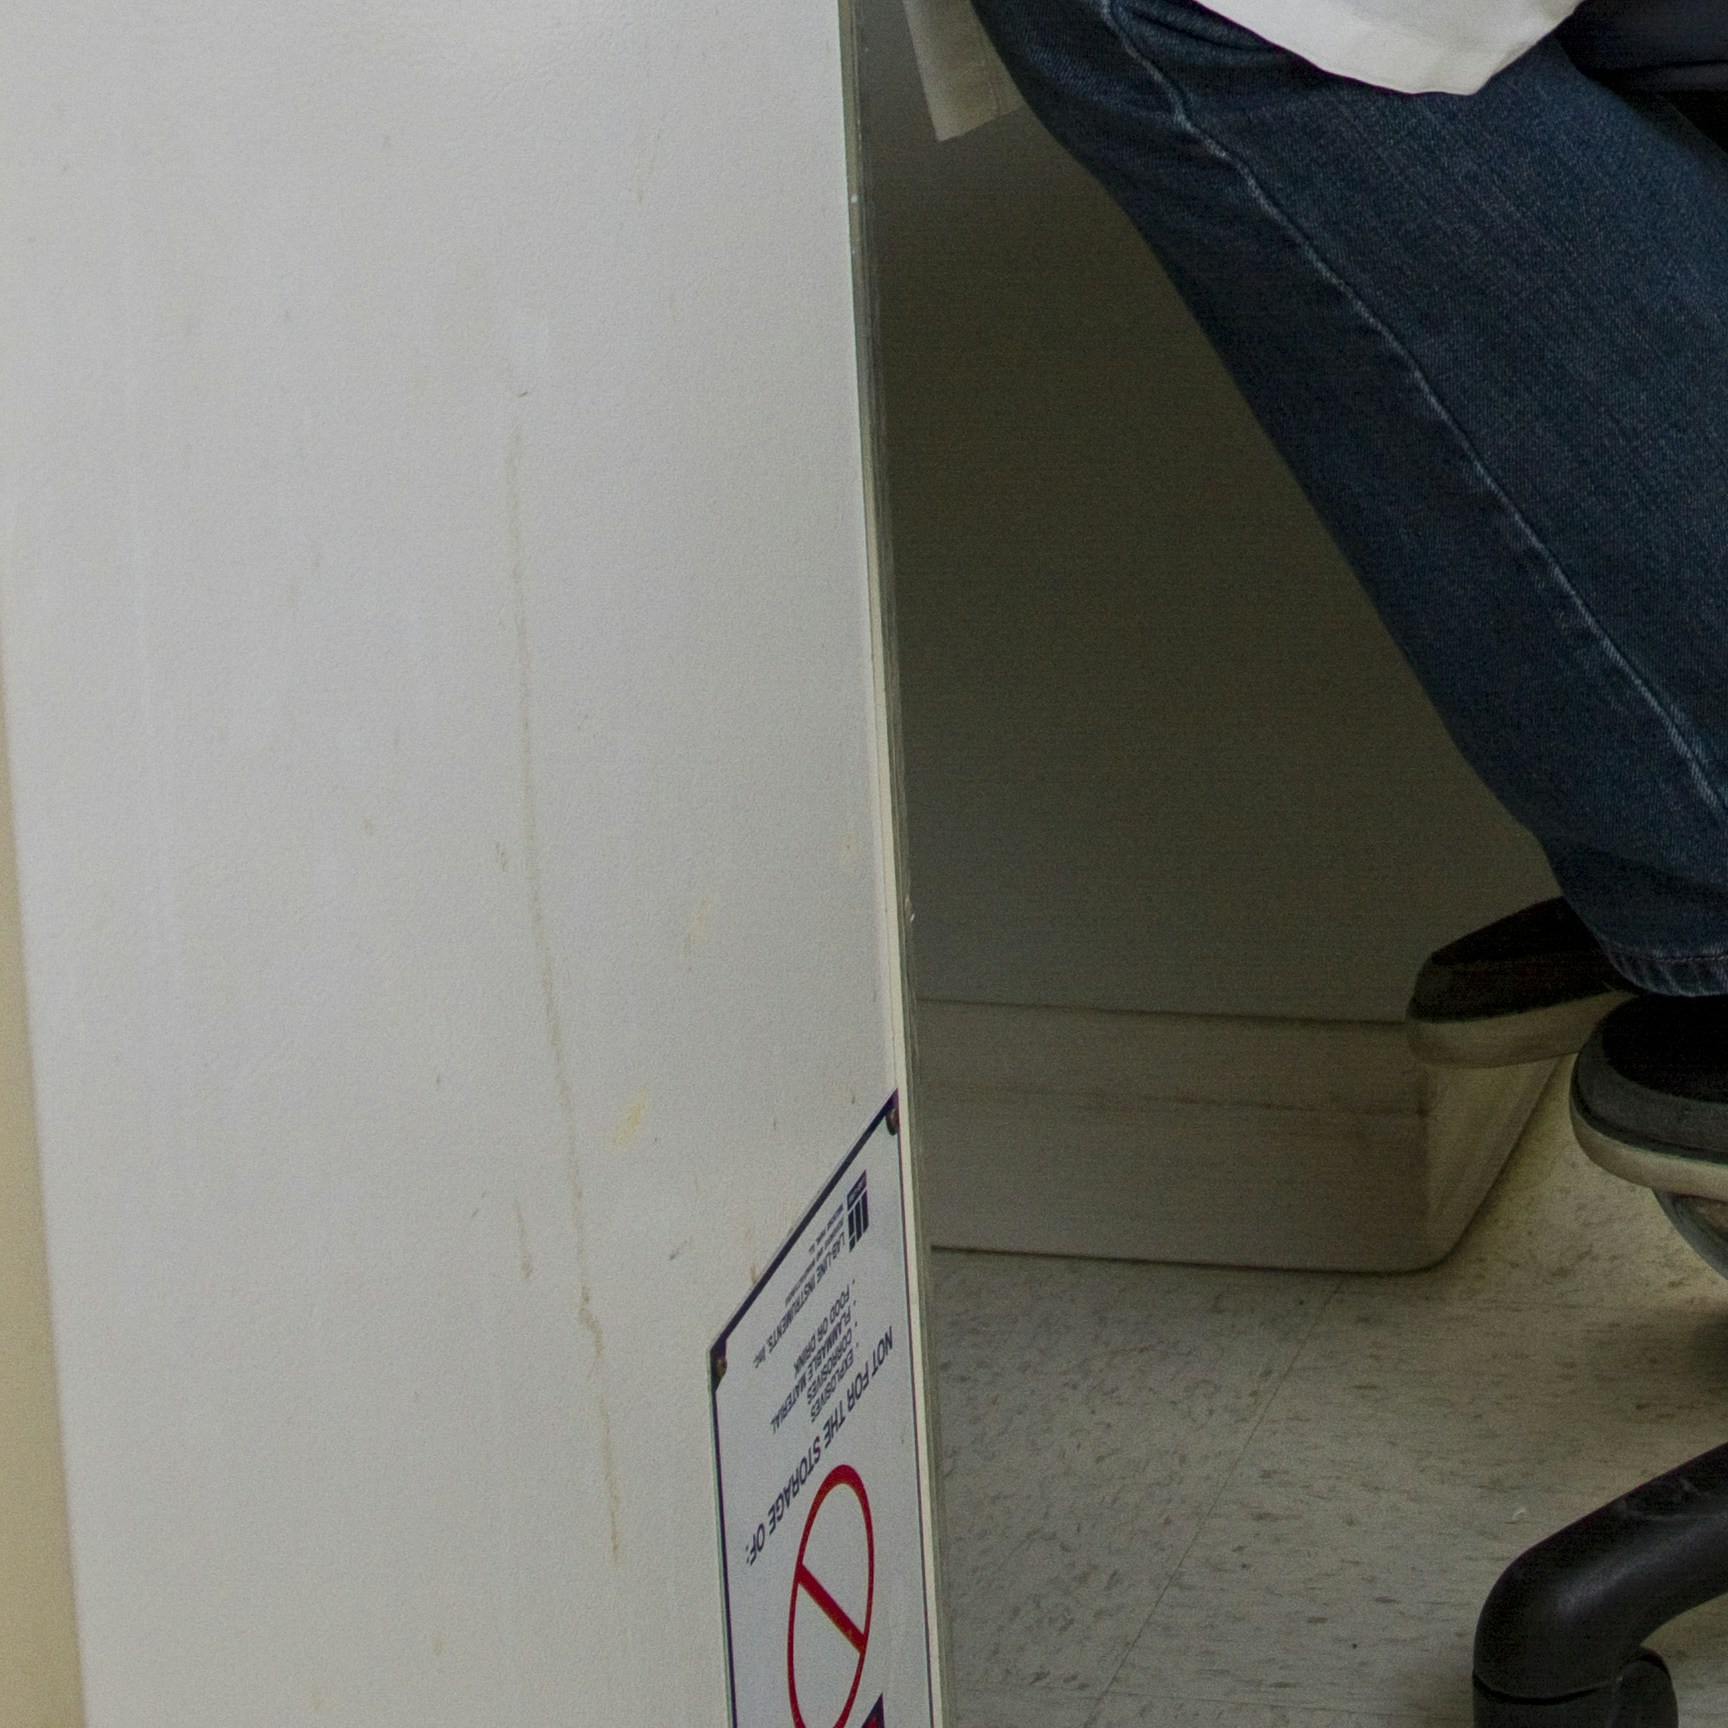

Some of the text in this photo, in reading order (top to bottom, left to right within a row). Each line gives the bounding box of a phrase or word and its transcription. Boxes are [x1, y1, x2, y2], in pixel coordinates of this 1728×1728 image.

[816, 1231, 845, 1285] LAB-LINE
[794, 1284, 850, 1379] FOOD OR DRINK
[807, 1328, 853, 1405] CORROSIVES
[871, 1325, 894, 1378] NOT
[770, 1306, 851, 1435] FLAMMABLE MATERIAL
[810, 1347, 854, 1424] EXPLOSIVES
[846, 1361, 871, 1412] FOR
[823, 1400, 847, 1449] THE
[768, 1435, 822, 1536] STORAGE
